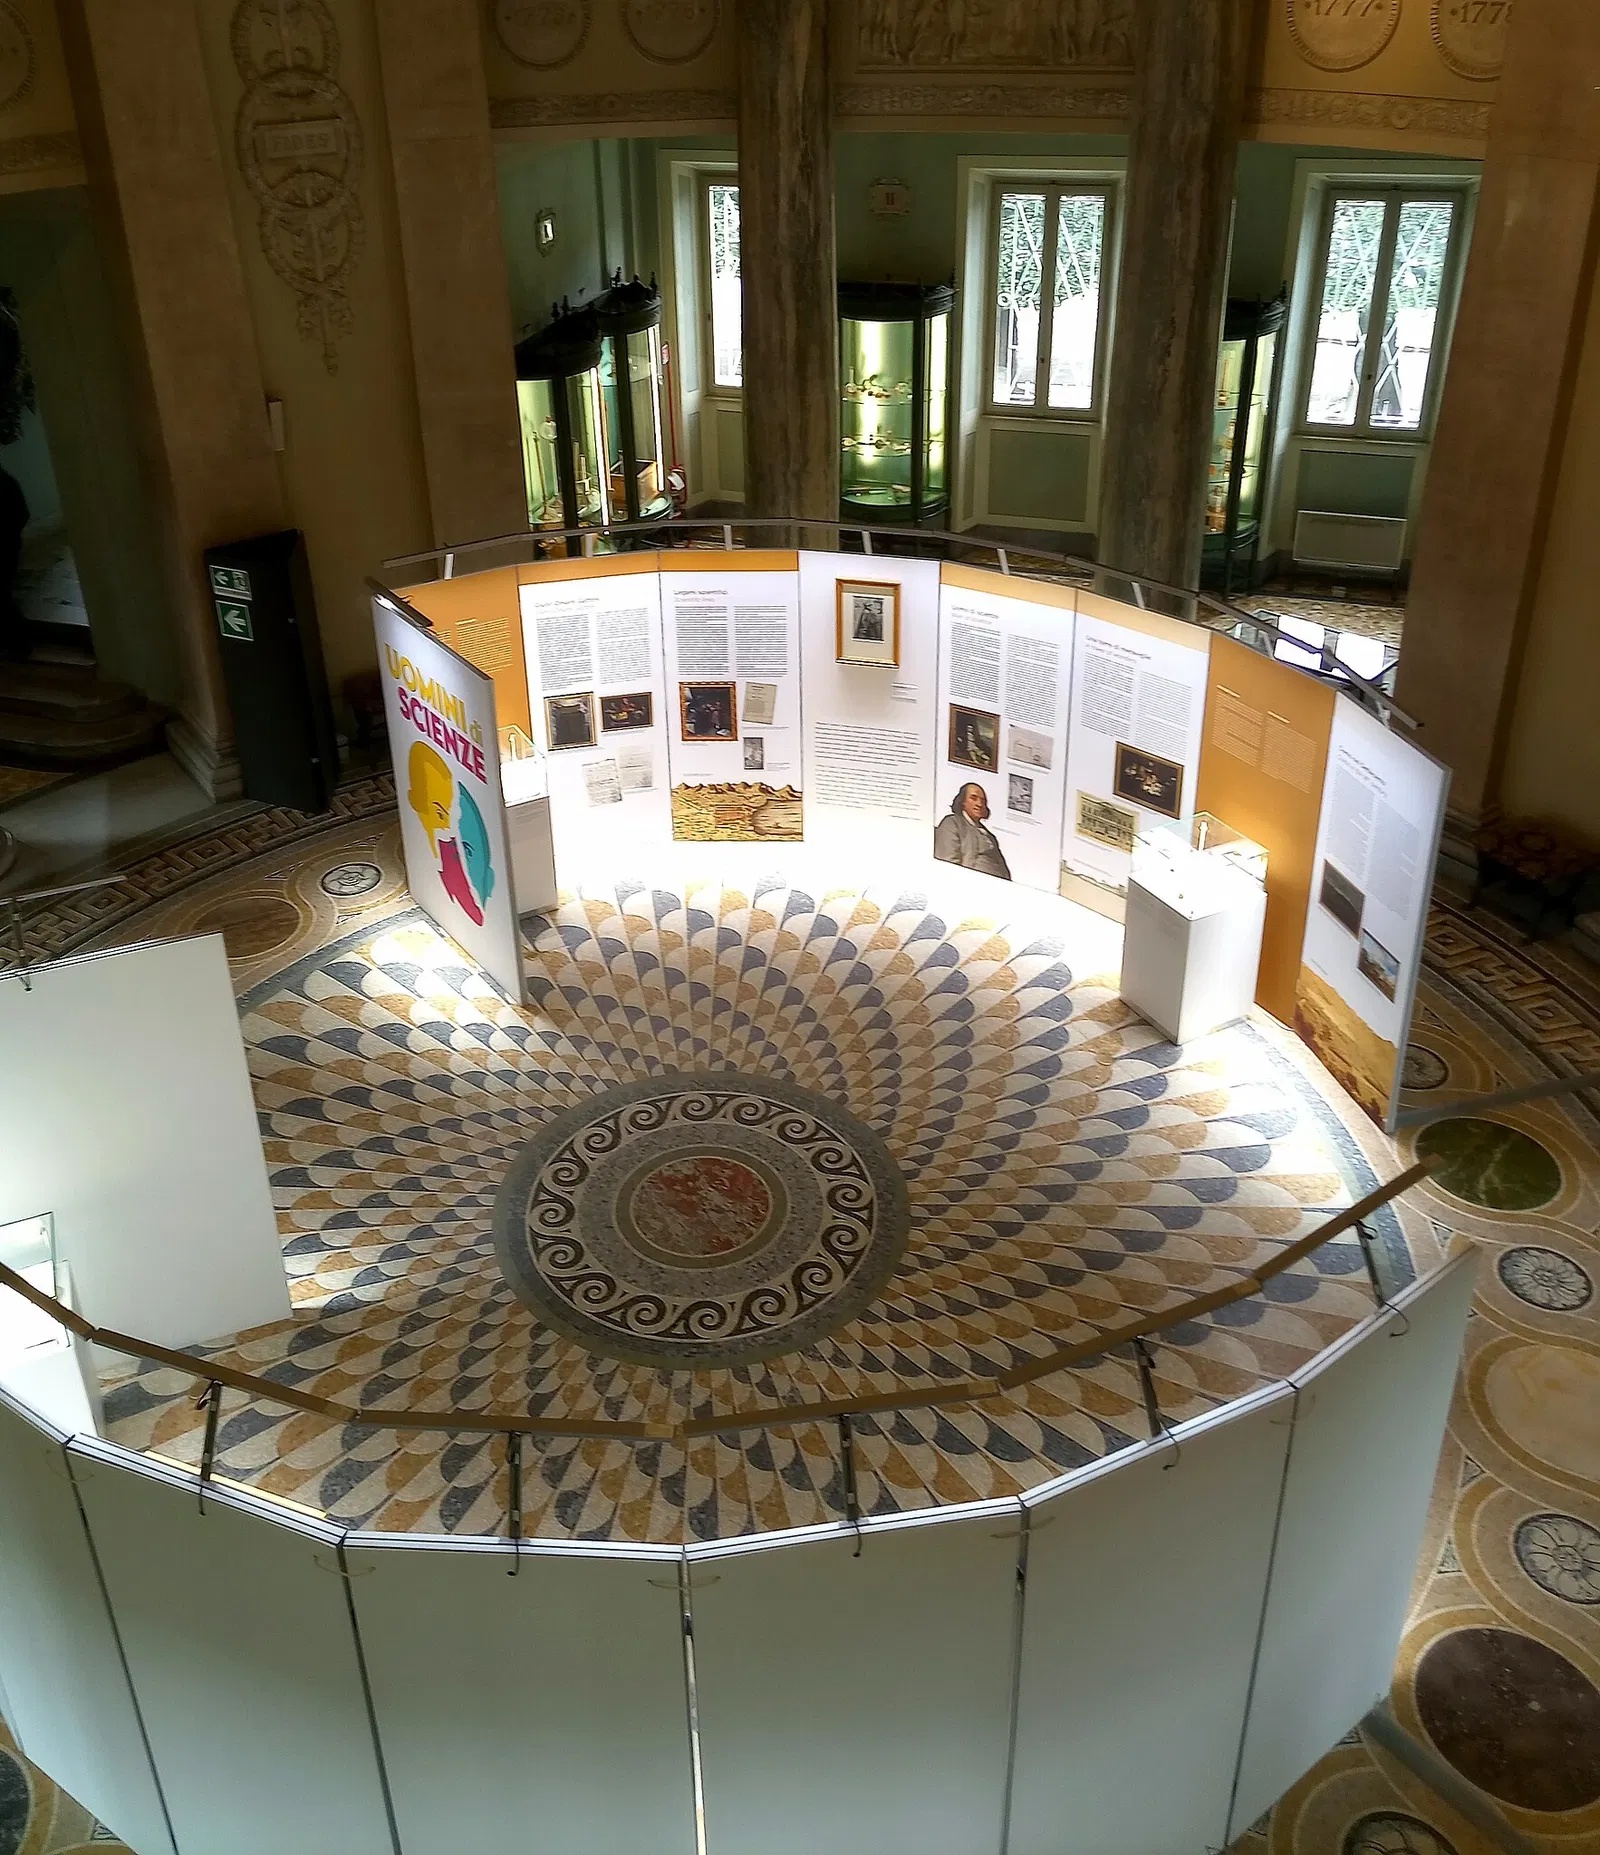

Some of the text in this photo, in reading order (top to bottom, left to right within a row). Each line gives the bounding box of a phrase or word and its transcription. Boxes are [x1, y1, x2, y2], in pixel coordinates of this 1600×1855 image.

[385, 642, 468, 734] UOMINI
[470, 719, 484, 747] di
[398, 686, 488, 785] SCIENZE
